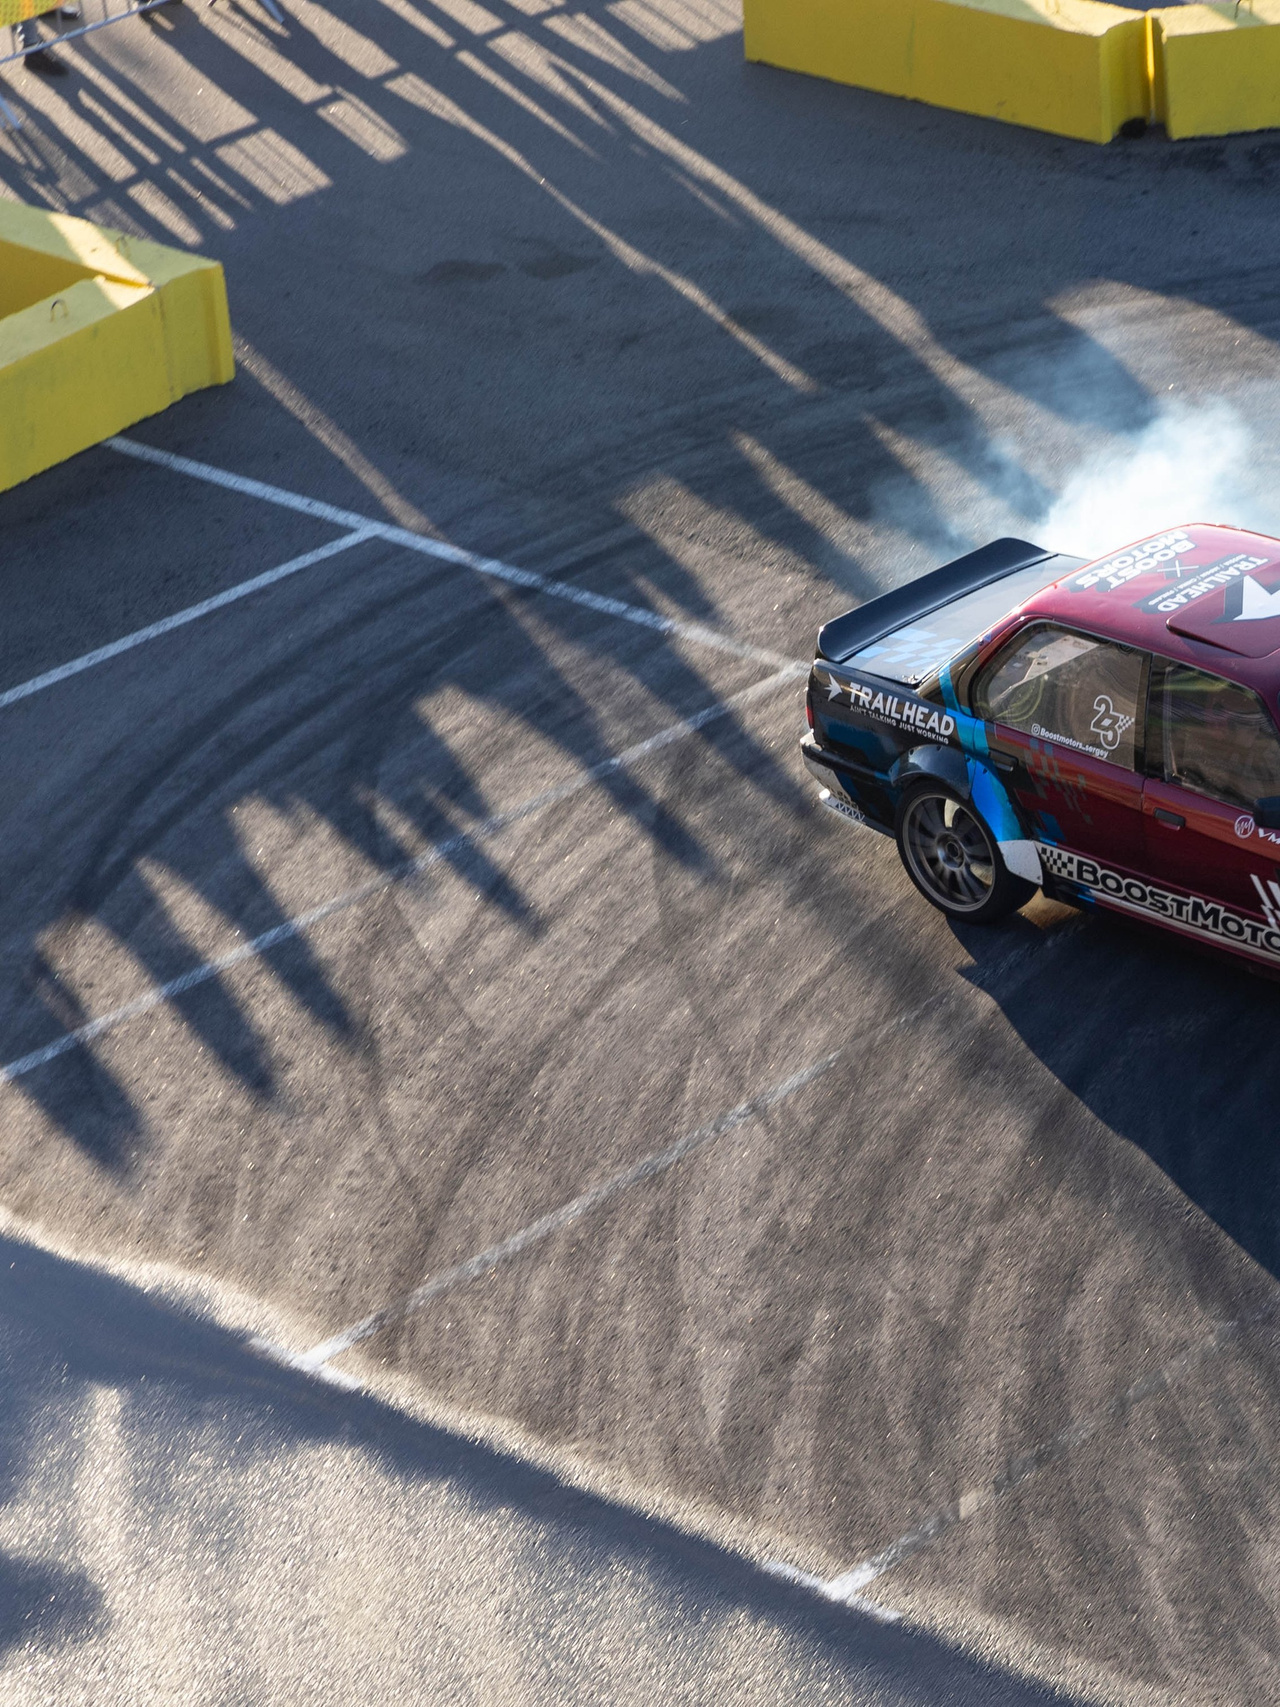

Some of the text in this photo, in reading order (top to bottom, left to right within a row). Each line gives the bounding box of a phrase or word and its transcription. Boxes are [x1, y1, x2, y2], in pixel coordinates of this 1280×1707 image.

[1075, 530, 1189, 588] MOTORS
[1106, 539, 1195, 590] BOOST
[1157, 556, 1269, 612] TRAILHEAD
[850, 682, 955, 736] TRAILHEAD
[868, 710, 897, 727] TALKING
[899, 722, 916, 733] JUST
[917, 727, 949, 744] WORKING
